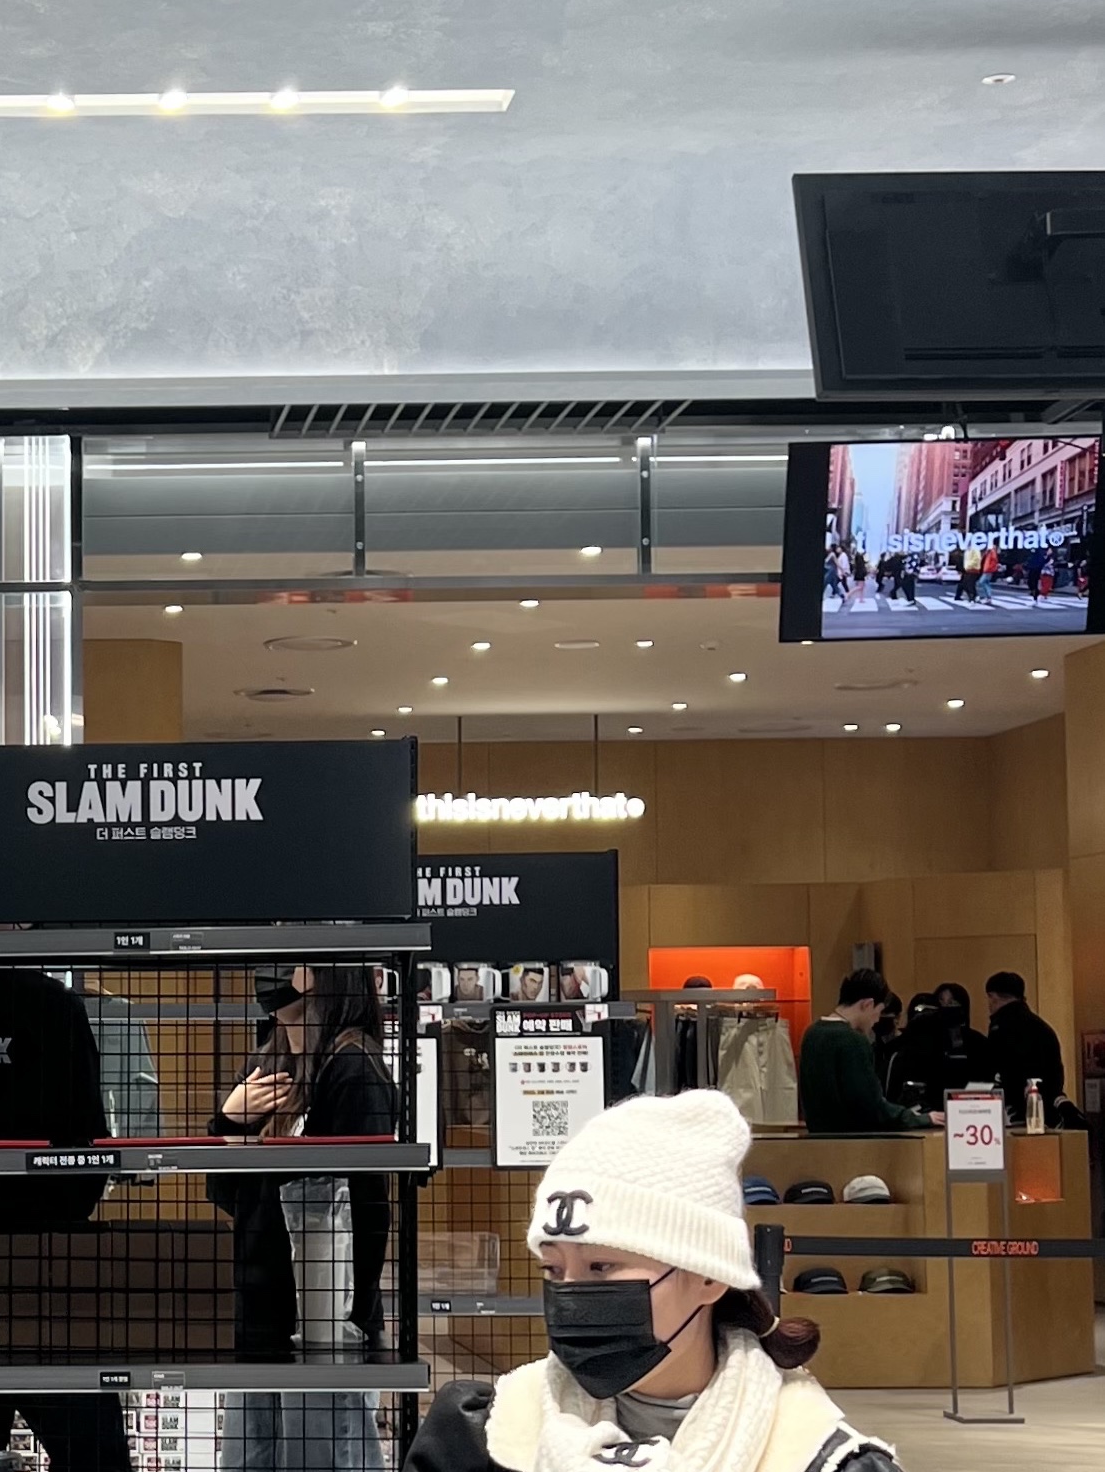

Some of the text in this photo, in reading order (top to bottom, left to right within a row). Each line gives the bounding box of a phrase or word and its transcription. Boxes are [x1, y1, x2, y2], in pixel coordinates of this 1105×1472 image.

[88, 762, 202, 779] THE FIRST
[26, 778, 264, 825] SLAM DUNK
[96, 826, 197, 840] 더 퍼스트 슬램덩크
[439, 866, 481, 877] FIRST
[446, 877, 520, 906] DUNK
[116, 935, 143, 946] 1인 1개
[523, 1019, 573, 1032] 예약 판매
[972, 1240, 1040, 1256] CREATIVE GROUND
